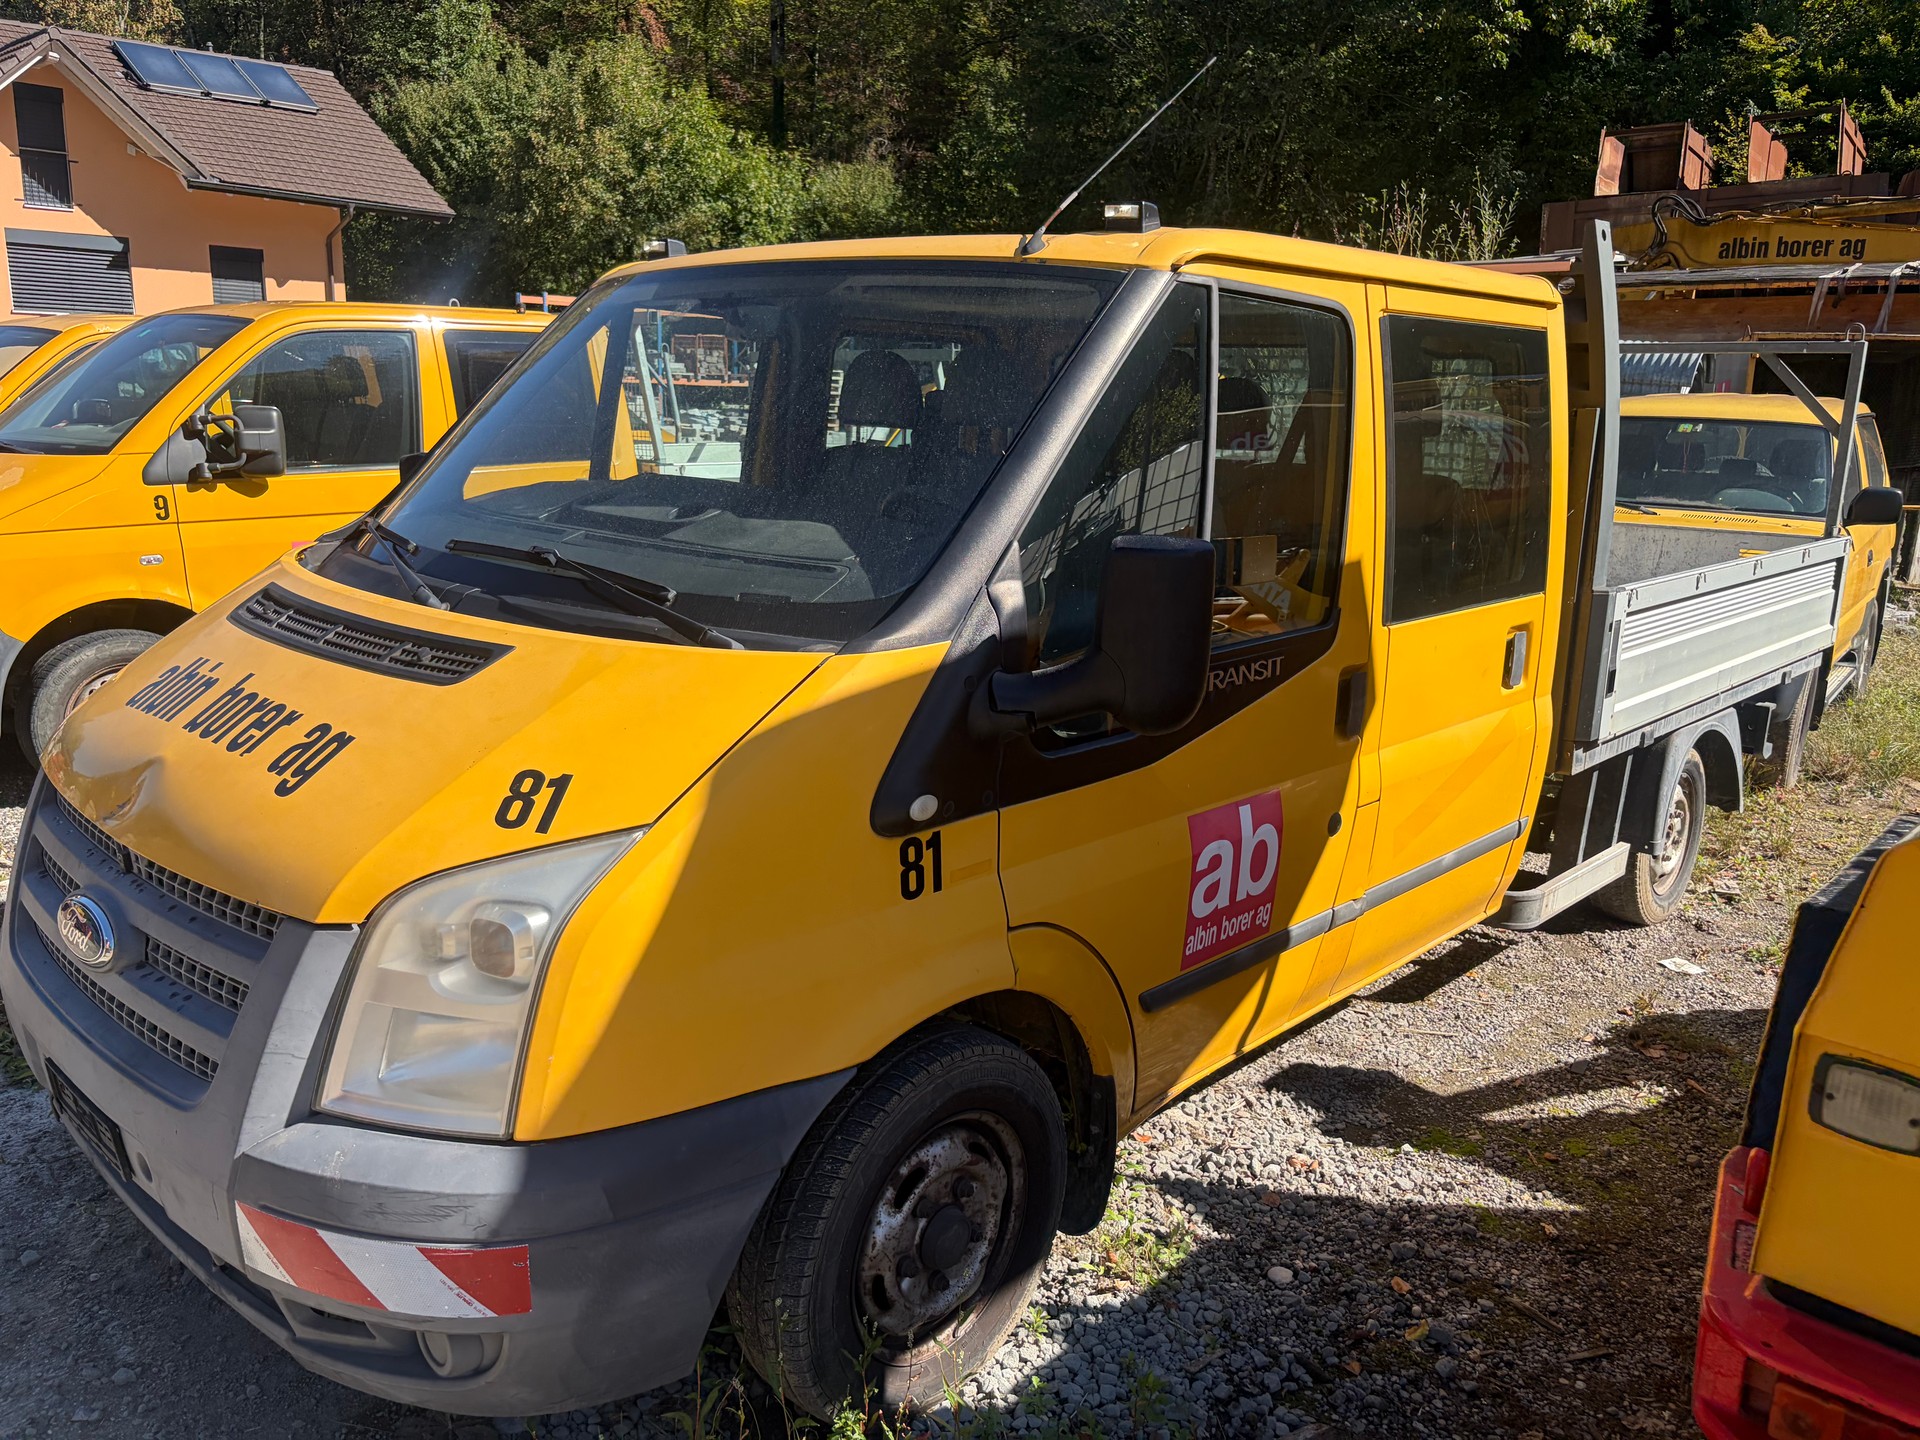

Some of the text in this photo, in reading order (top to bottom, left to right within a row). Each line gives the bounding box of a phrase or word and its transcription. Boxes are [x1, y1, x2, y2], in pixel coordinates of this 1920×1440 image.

[1718, 236, 1867, 260] albin borer ag
[154, 495, 170, 520] 9
[1208, 656, 1285, 692] RANSIT
[126, 656, 357, 797] albin borer ag
[494, 769, 574, 834] 81
[900, 830, 942, 900] 81
[1191, 804, 1279, 919] ab
[60, 906, 93, 953] Ford
[1185, 902, 1273, 956] albin borer ag
